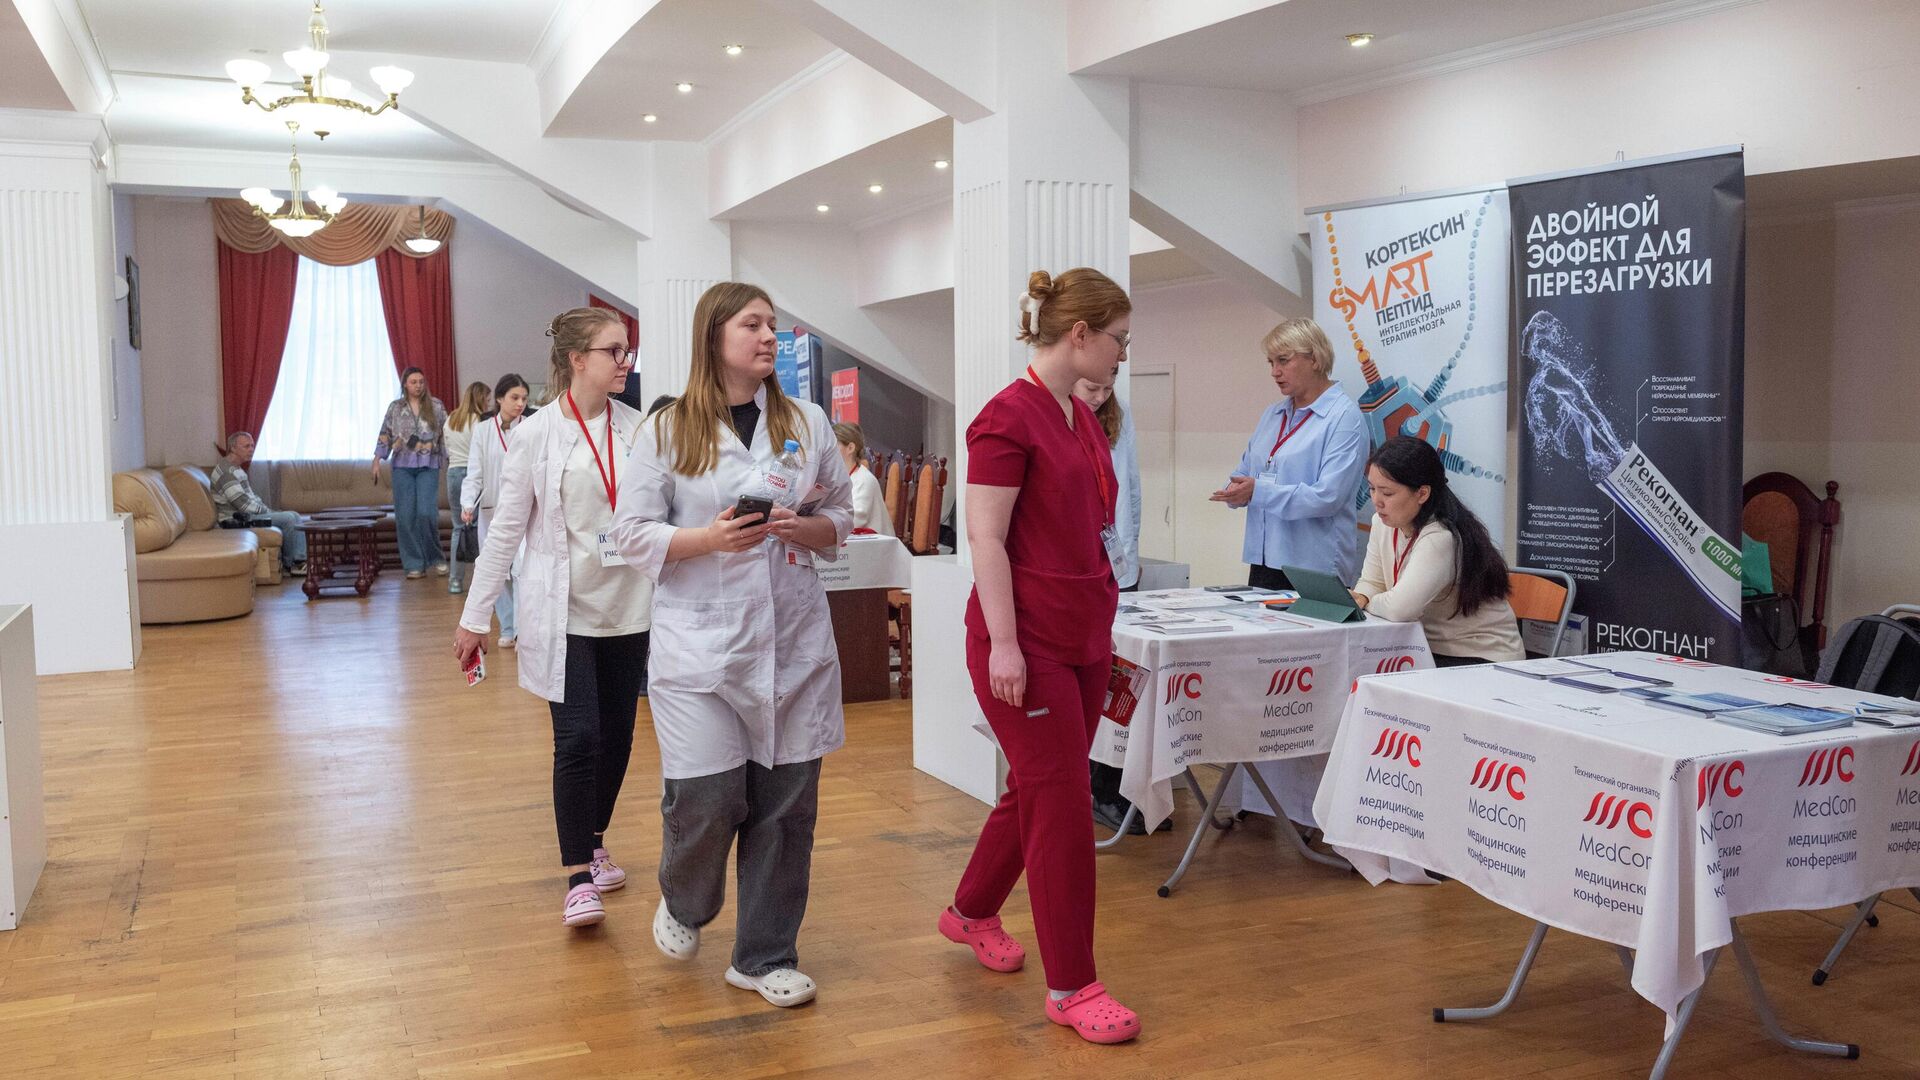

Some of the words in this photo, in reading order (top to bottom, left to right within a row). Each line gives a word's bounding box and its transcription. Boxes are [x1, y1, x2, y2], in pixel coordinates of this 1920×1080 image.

[1527, 194, 1659, 243] ДВОЙНОЙ
[1527, 234, 1629, 268] ЭФФЕКТ
[1635, 228, 1691, 263] ДЛЯ
[1329, 250, 1433, 321] SMART
[1527, 258, 1712, 298] ПЕРЕЗАГРУЗКИ
[1376, 292, 1434, 326] ПЕПТИД
[1380, 300, 1462, 338] ИНТЕЛЛЕКТУАЛЬНАЯ
[1381, 328, 1417, 347] ТЕРАПИЯ
[1419, 318, 1446, 334] МОЗГА
[604, 550, 620, 559] УЧАС
[1706, 540, 1733, 566] 1000
[1263, 700, 1313, 718] MedCon
[1364, 707, 1398, 723] Технический
[1399, 717, 1431, 733] организатор
[1260, 723, 1314, 739] медицинские
[1258, 739, 1315, 753] конференции
[1463, 733, 1498, 752] Технический
[1499, 745, 1536, 763] организатор
[1365, 765, 1423, 797] MedCon
[1573, 766, 1616, 787] Технический
[1359, 796, 1424, 822] медицинские
[1468, 796, 1526, 833] MedCon
[1793, 795, 1856, 819] MedCon
[1356, 814, 1425, 840] конференции
[1788, 829, 1857, 848] медицинские
[1467, 827, 1526, 858] медицинские
[1467, 846, 1526, 878] конференции
[1786, 849, 1857, 870] конференции
